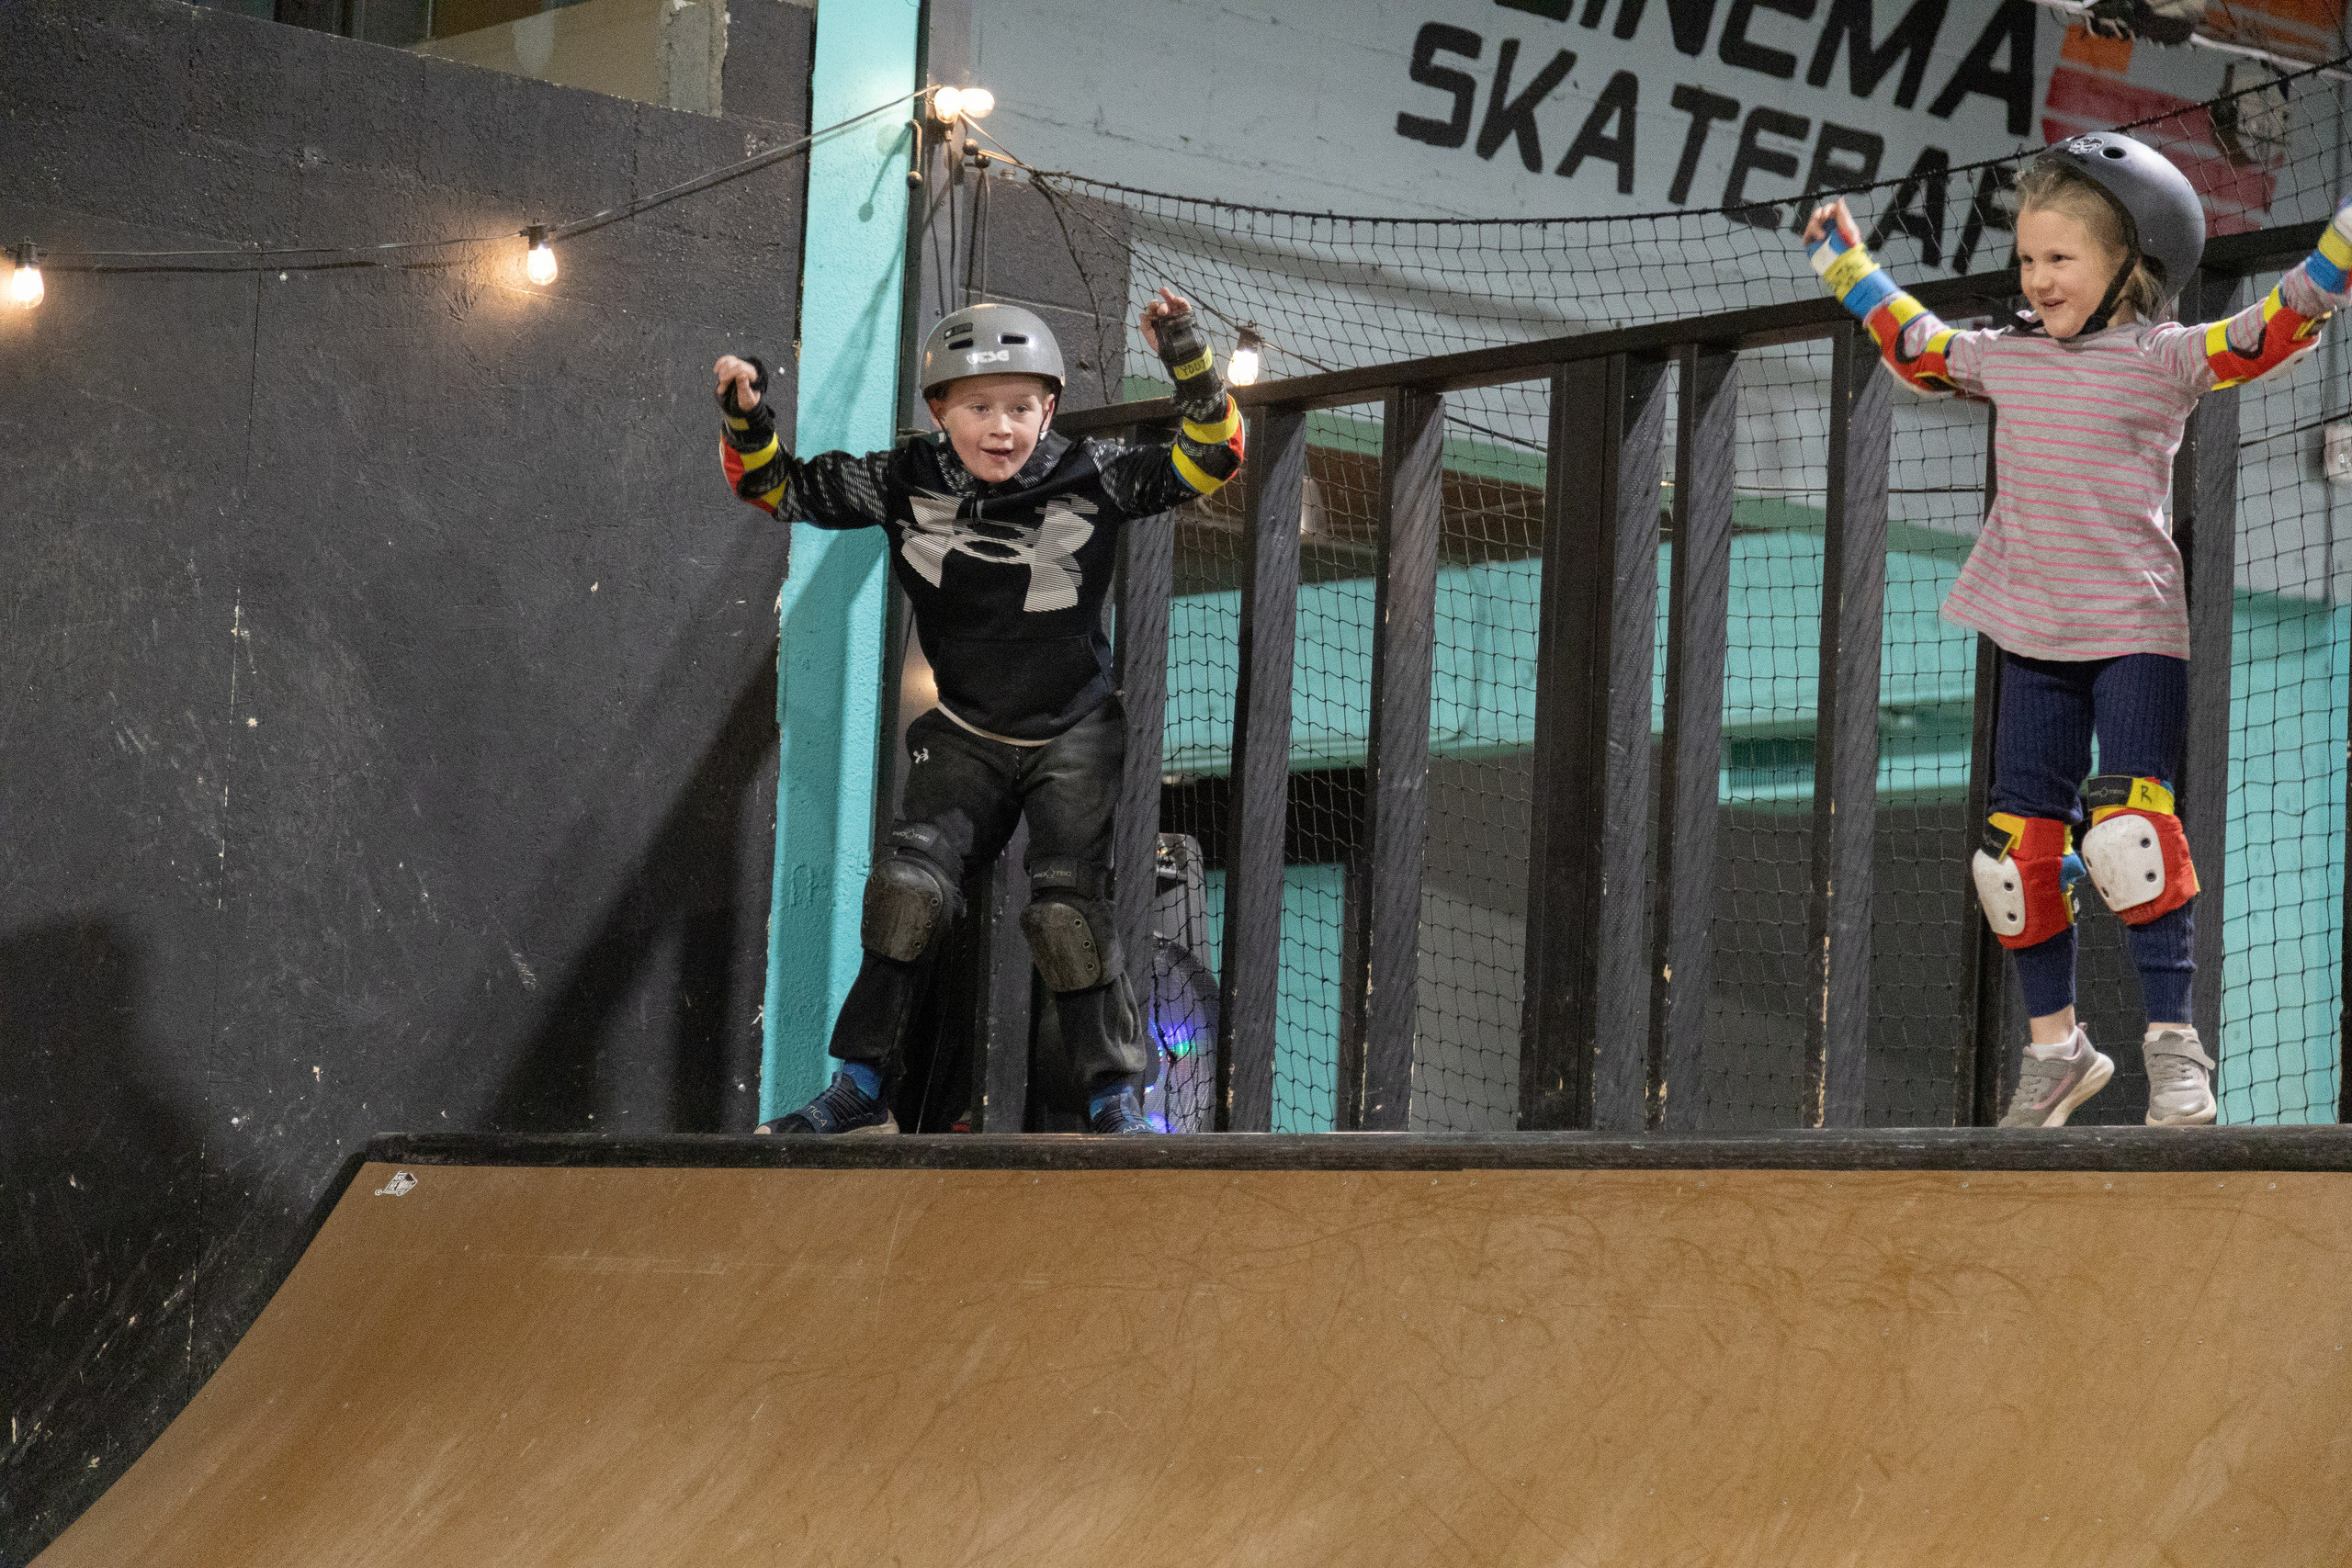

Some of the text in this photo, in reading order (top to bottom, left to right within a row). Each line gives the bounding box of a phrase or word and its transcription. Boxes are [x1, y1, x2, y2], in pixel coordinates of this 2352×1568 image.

[1492, 0, 2033, 136] EMA
[1396, 21, 2020, 276] SKATEPAR
[2141, 784, 2153, 804] R
[805, 1105, 828, 1128] TICA
